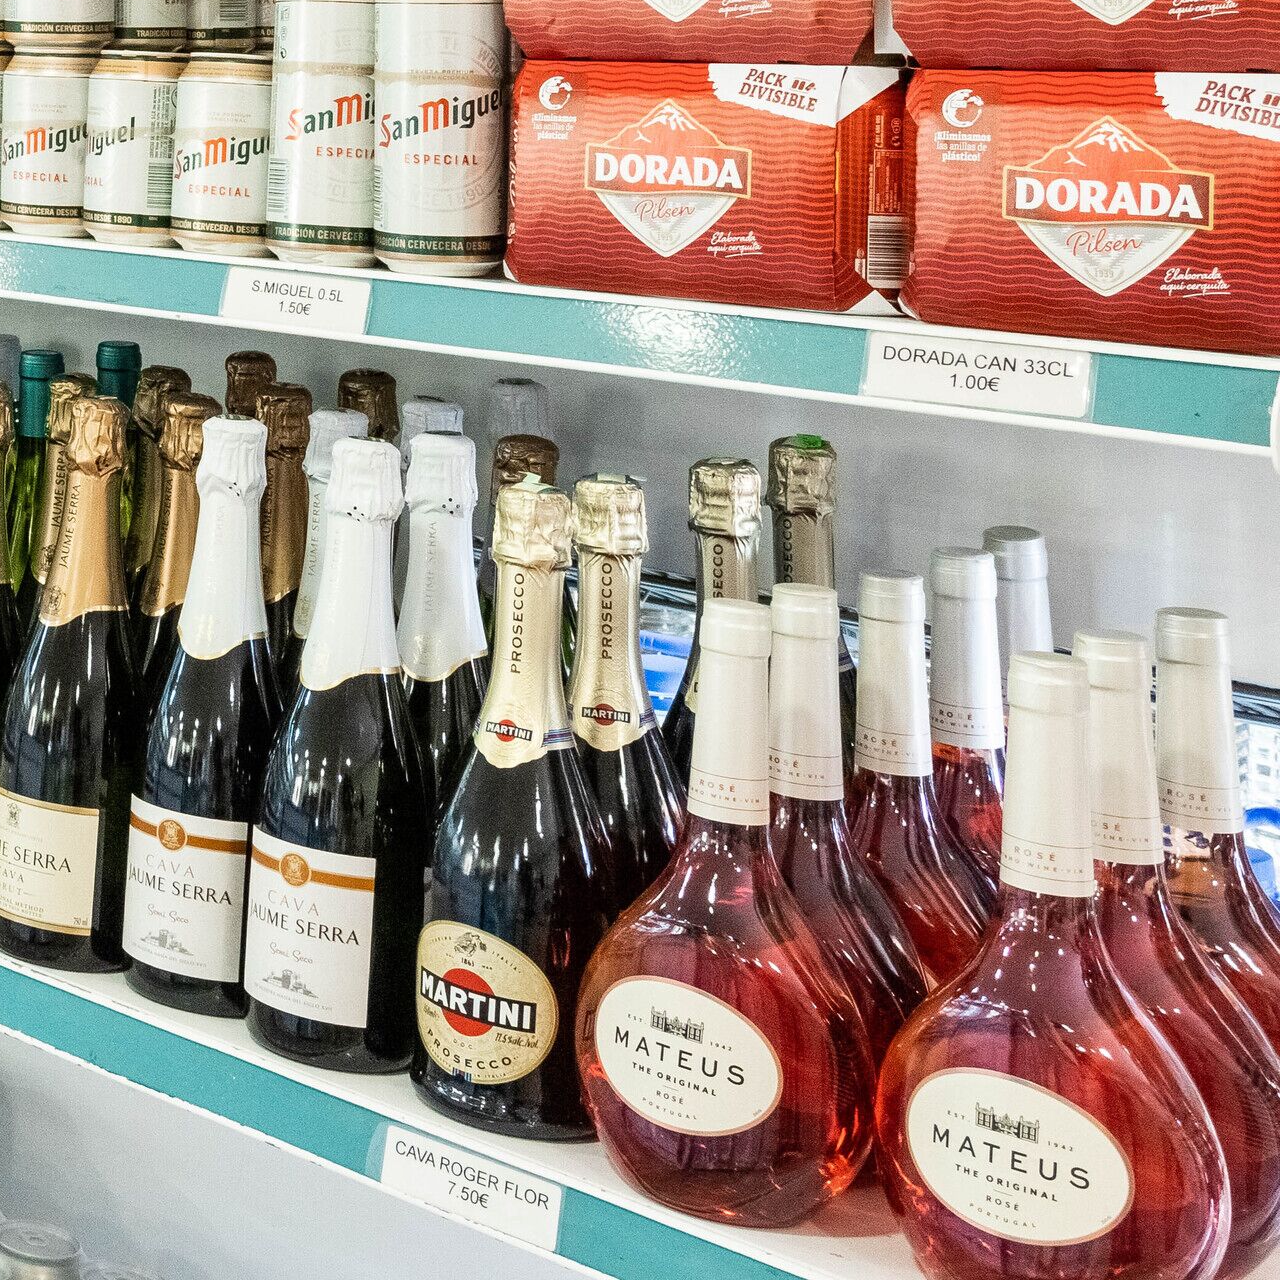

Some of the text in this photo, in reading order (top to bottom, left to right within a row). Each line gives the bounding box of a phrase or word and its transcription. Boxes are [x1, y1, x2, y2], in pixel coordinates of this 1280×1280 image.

[746, 69, 787, 87] PACK
[1203, 81, 1255, 103] PACK
[739, 82, 817, 111] DIVISIBLE
[404, 153, 478, 166] ESPECIAL
[595, 152, 742, 188] DORADA
[13, 171, 68, 182] ESPECIAL
[188, 184, 251, 197] ESPECIAL
[634, 197, 696, 221] Pilsen
[1015, 177, 1202, 218] DORADA
[1066, 229, 1142, 257] Pilsen
[252, 280, 343, 302] S.MIGUEL 0.5L
[279, 300, 312, 316] 1.50€
[883, 346, 1073, 377] DORADA CAN 33CL
[951, 374, 1000, 392] 1.00€
[511, 573, 525, 674] PROSECCO
[601, 563, 613, 659] PROSECCO
[583, 707, 629, 722] MARTINI
[487, 723, 530, 739] MARTINI
[13, 842, 72, 873] SERRA
[145, 853, 195, 879] CAVA
[129, 861, 232, 906] JAUME SERRA
[268, 889, 320, 917] CAVA
[422, 971, 531, 1029] MARTINI
[428, 1029, 512, 1072] PROSECCO
[615, 1026, 744, 1088] MATEUS
[633, 1062, 716, 1099] THE ORIGINAL
[933, 1124, 1089, 1192] MATEUS
[396, 1141, 549, 1210] CAVA ROGER FLOR
[956, 1164, 1057, 1205] THE ORIGINAL
[449, 1181, 489, 1208] 7.50€
